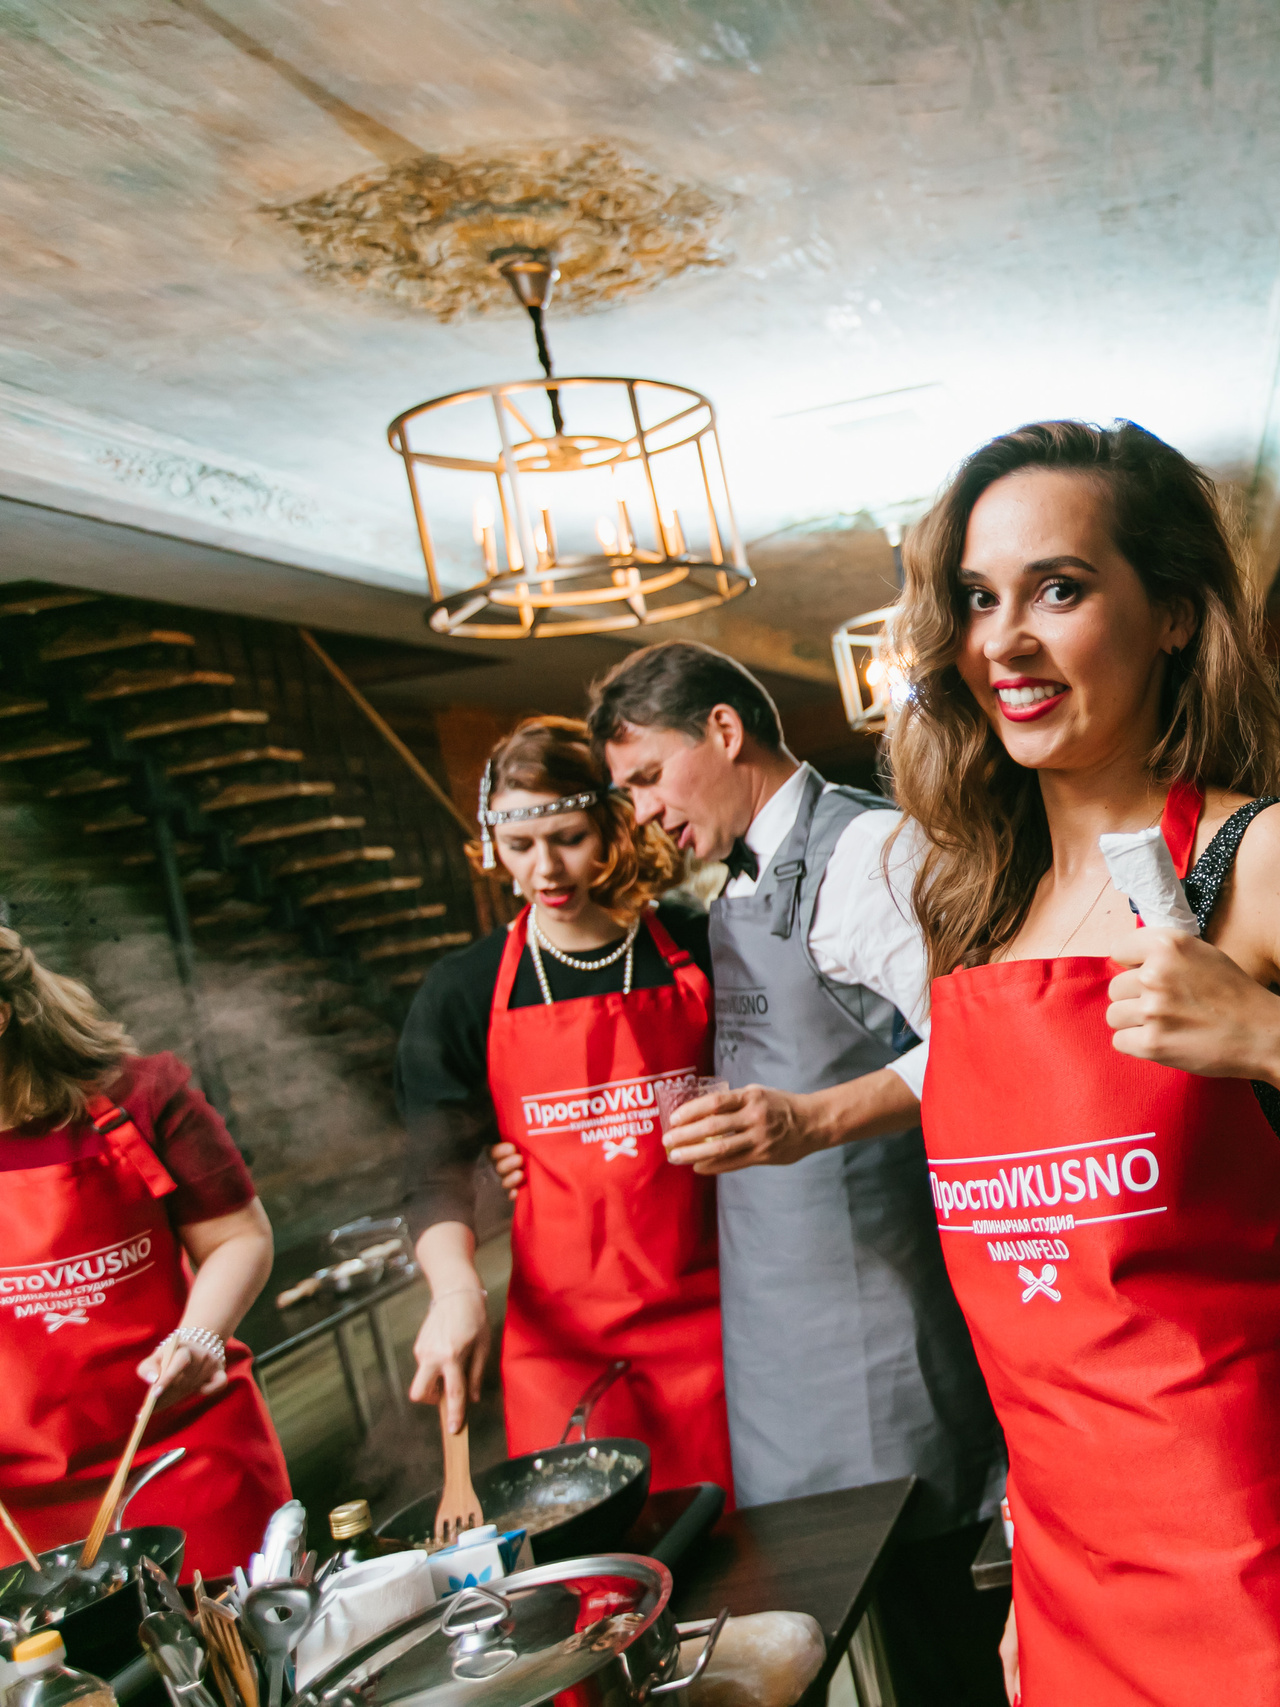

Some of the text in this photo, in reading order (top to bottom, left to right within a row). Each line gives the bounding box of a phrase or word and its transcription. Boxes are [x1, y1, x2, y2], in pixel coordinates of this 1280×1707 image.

[581, 1119, 654, 1144] MAUNFELD
[930, 1148, 1159, 1219] ПростоVKUSNO
[972, 1214, 1075, 1234] КУЛИНАРНАЯ СТУДИЯ
[987, 1239, 1070, 1261] MAUNFELD
[1, 1277, 115, 1306] КУЛИНАРНАЯ СТУДИЯ
[15, 1292, 107, 1319] MAUNFELD
